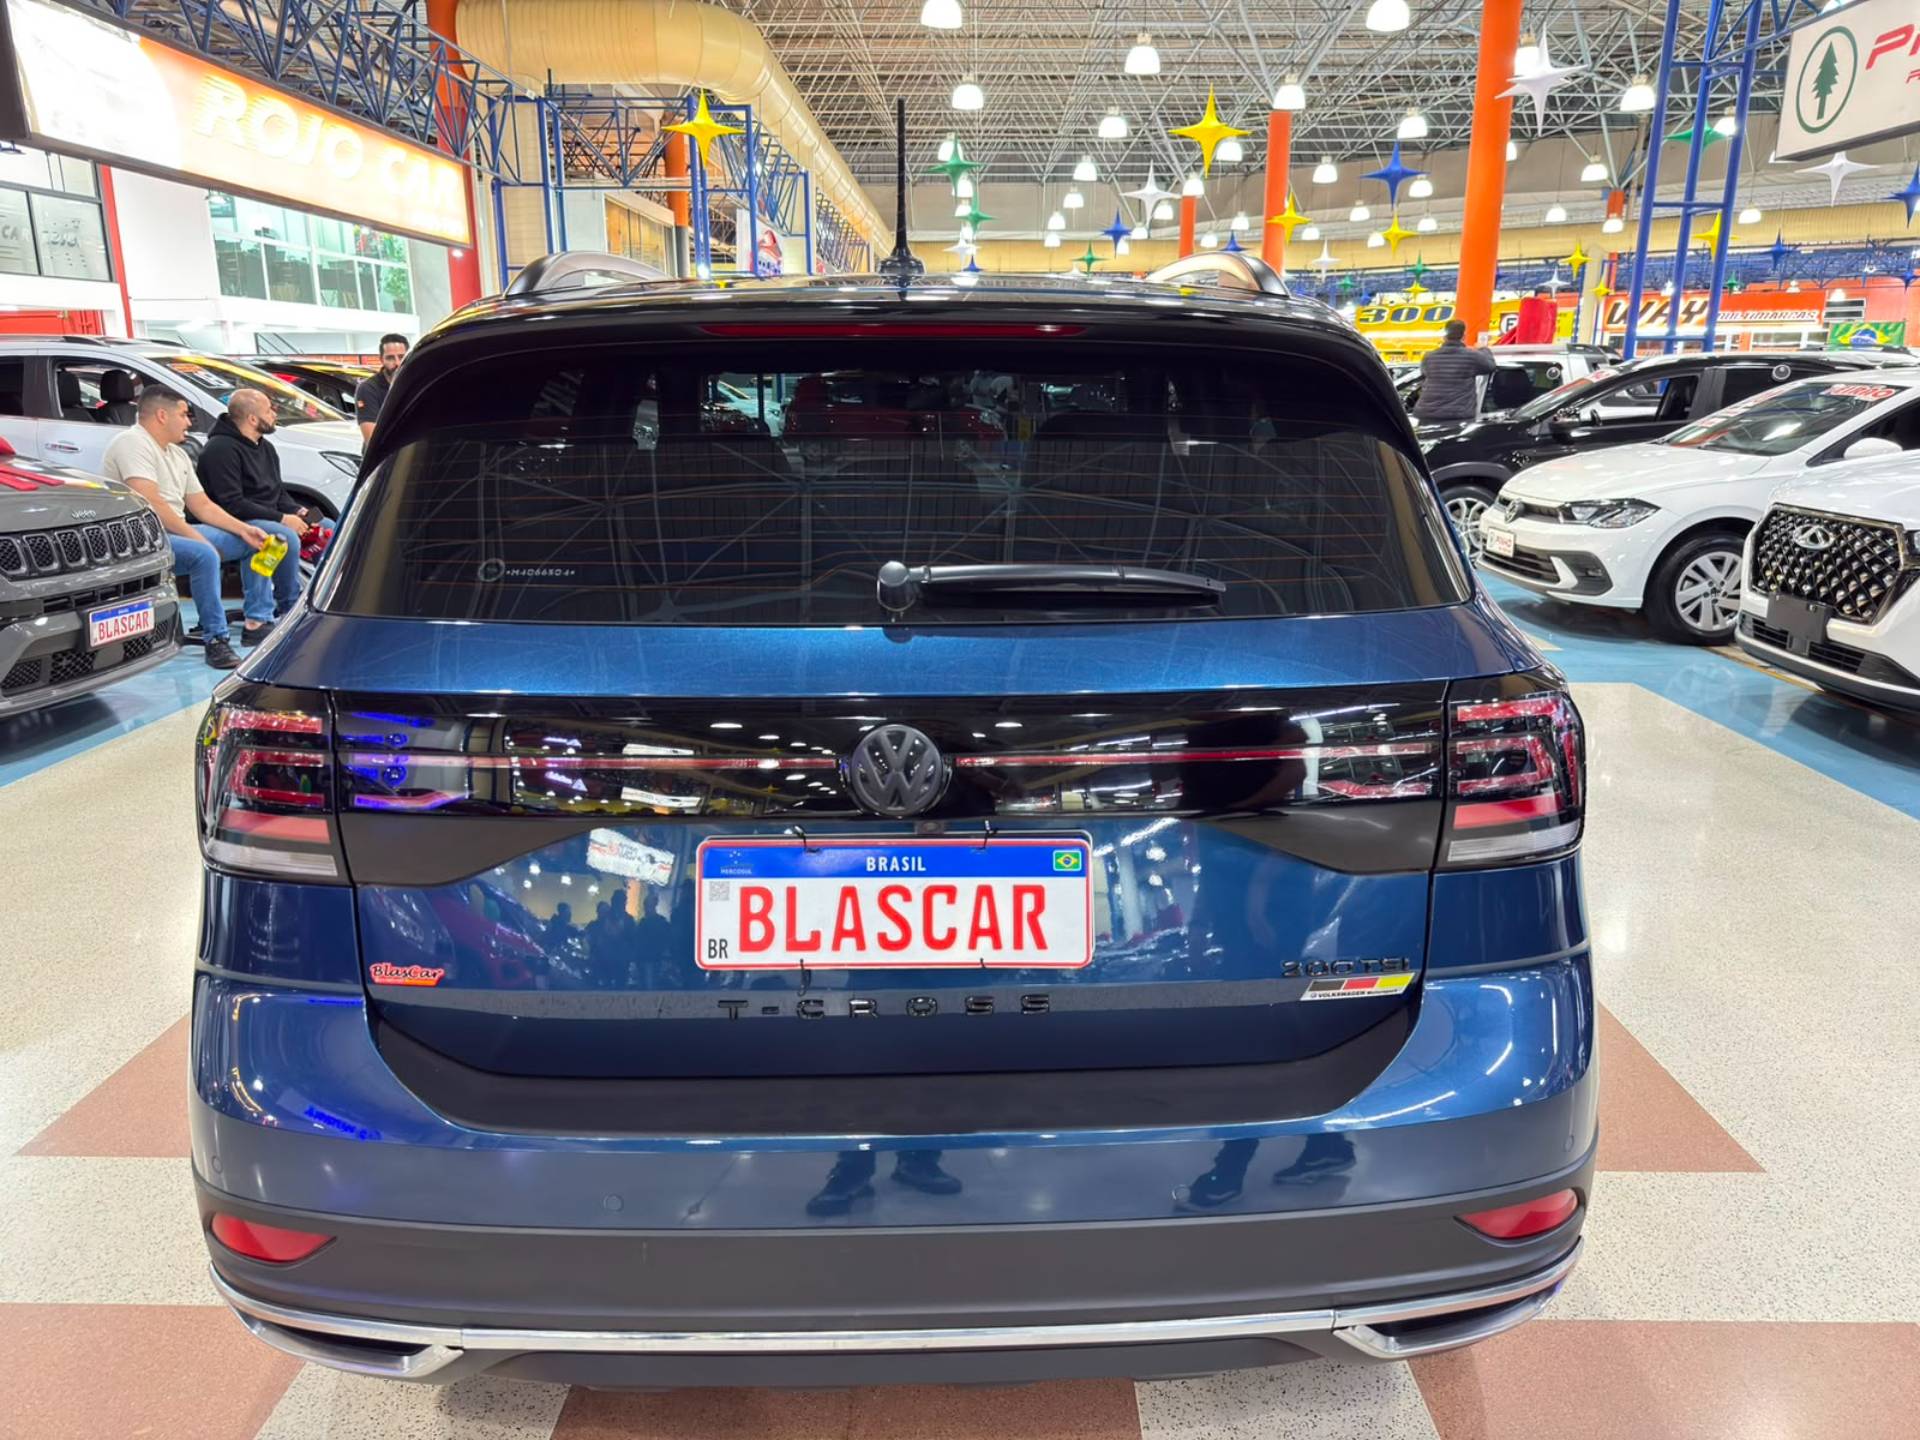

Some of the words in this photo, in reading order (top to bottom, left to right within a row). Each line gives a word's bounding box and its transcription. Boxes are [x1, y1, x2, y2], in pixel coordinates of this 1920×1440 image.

[193, 75, 363, 179] ROJO
[1606, 297, 1710, 327] WAY
[98, 611, 149, 640] BLASCAR
[866, 856, 927, 872] BRASIL
[739, 885, 1049, 952] BLASCAR
[707, 938, 729, 960] BR
[373, 963, 443, 979] BlasCar
[717, 993, 1051, 1020] T-CROSS
